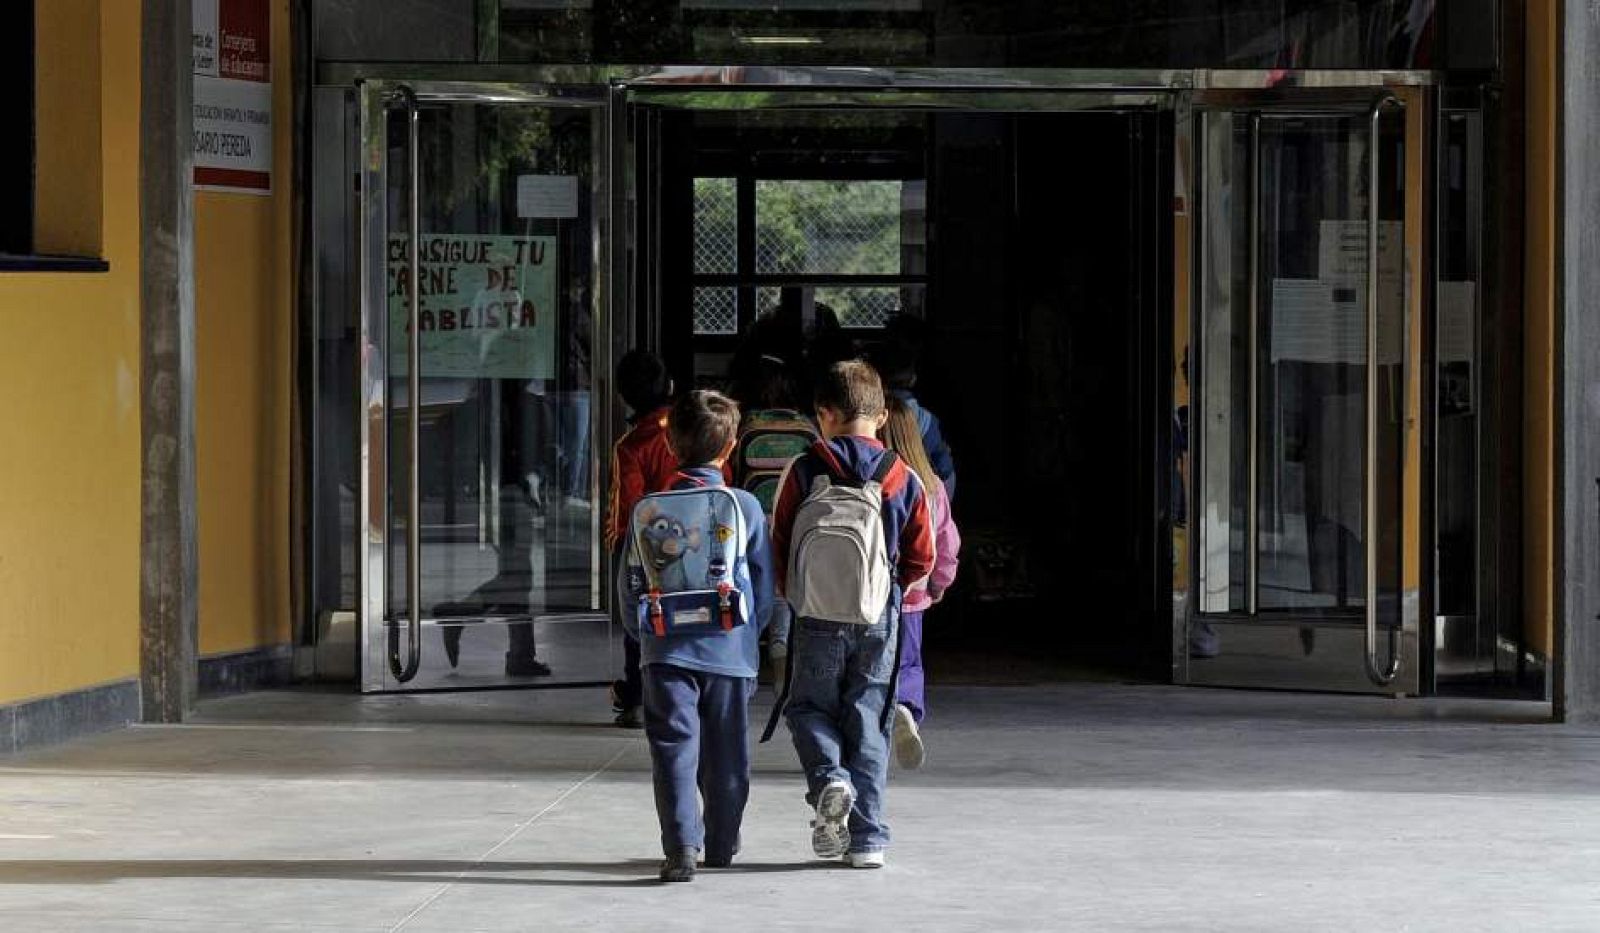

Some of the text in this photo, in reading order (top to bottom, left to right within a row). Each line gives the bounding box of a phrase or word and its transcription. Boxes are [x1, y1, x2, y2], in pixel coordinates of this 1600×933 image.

[221, 133, 252, 157] PEREDA
[512, 240, 545, 265] TU
[487, 265, 518, 291] DE
